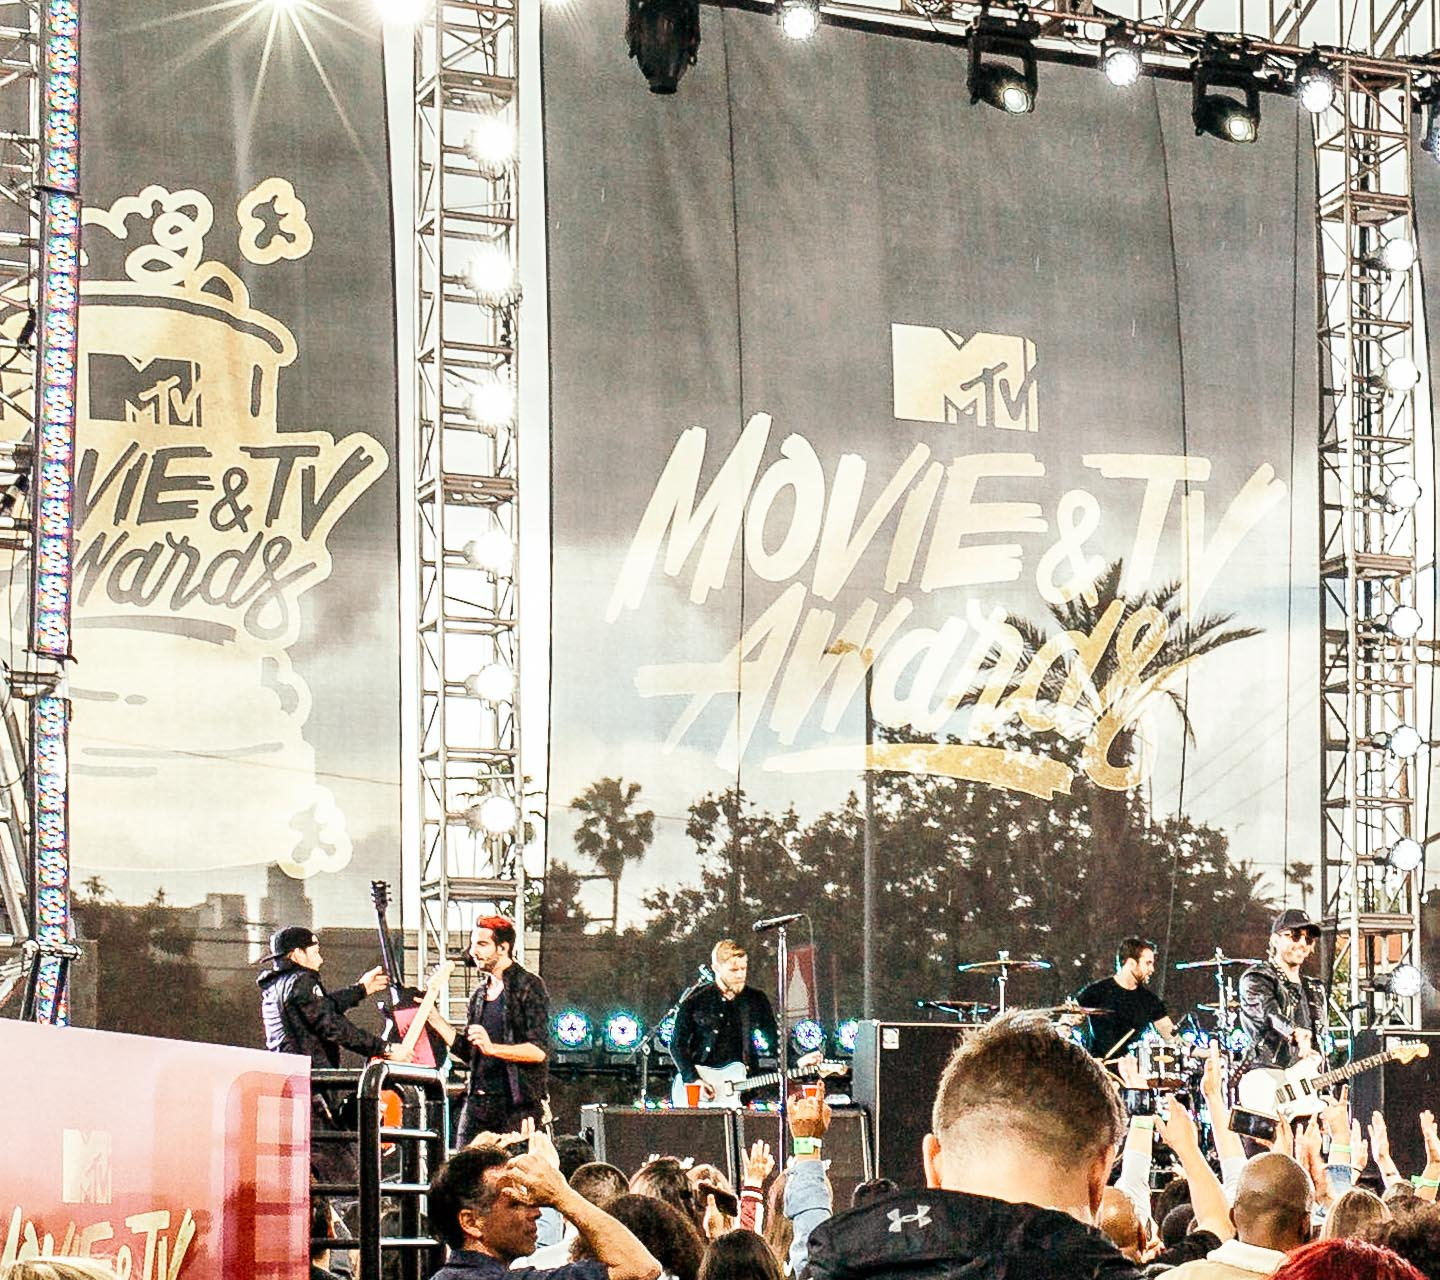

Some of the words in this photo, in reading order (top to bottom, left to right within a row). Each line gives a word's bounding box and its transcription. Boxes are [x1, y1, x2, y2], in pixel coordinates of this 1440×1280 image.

[88, 352, 203, 428] MTV
[892, 323, 1038, 432] MTV
[74, 441, 214, 530] VIE
[605, 411, 1048, 624] MOVIE
[63, 1127, 112, 1205] MTV
